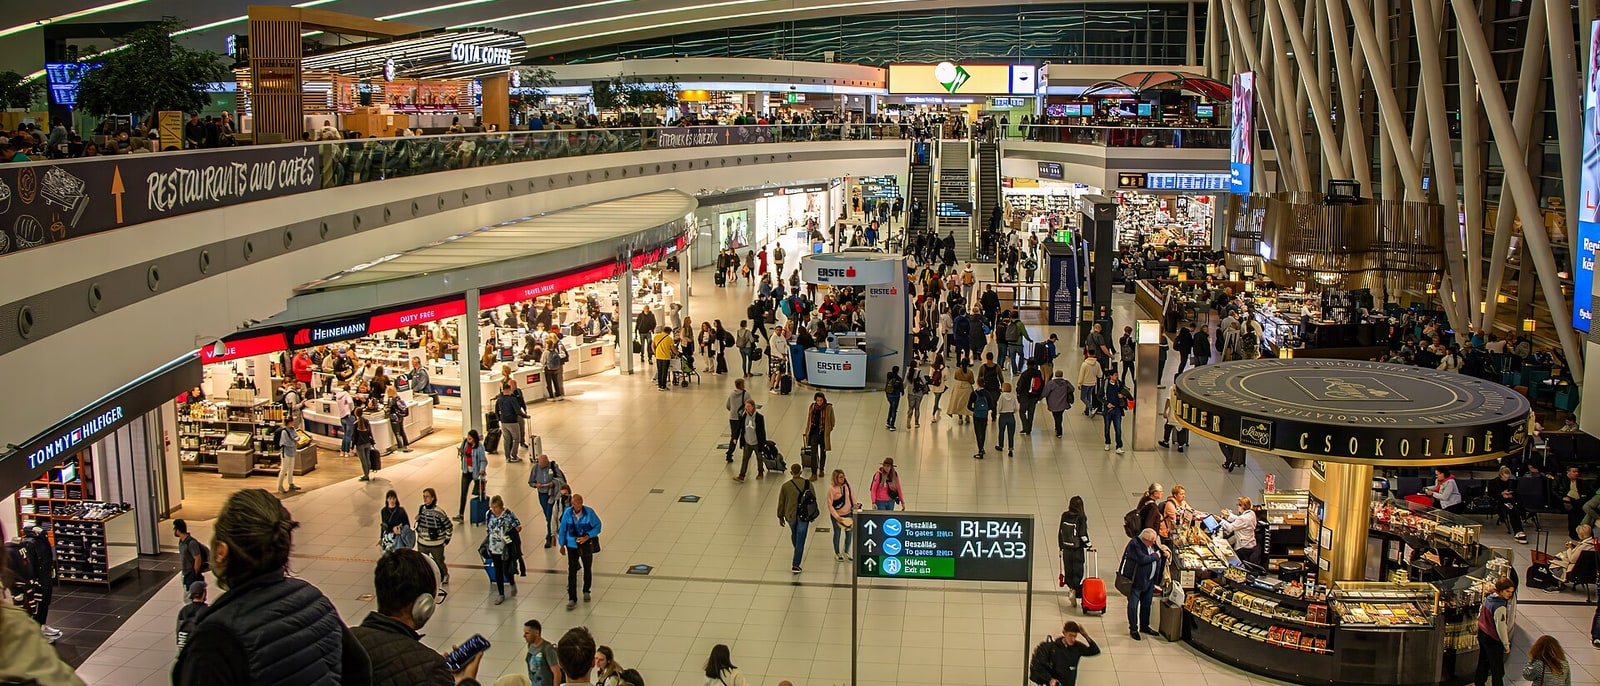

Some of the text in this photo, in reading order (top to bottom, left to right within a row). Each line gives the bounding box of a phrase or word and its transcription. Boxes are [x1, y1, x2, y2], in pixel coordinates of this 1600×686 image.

[451, 41, 512, 65] COSTA COFFEE
[817, 267, 845, 278] ERSTE
[870, 287, 890, 295] ERSTE
[400, 310, 435, 323] DUTY FREE
[313, 323, 366, 341] HEINEMANN
[817, 361, 842, 371] ERSTE
[28, 406, 124, 469] TOMMY HILFIGER
[959, 520, 1023, 539] B1-B44
[959, 540, 1026, 559] A1-A33
